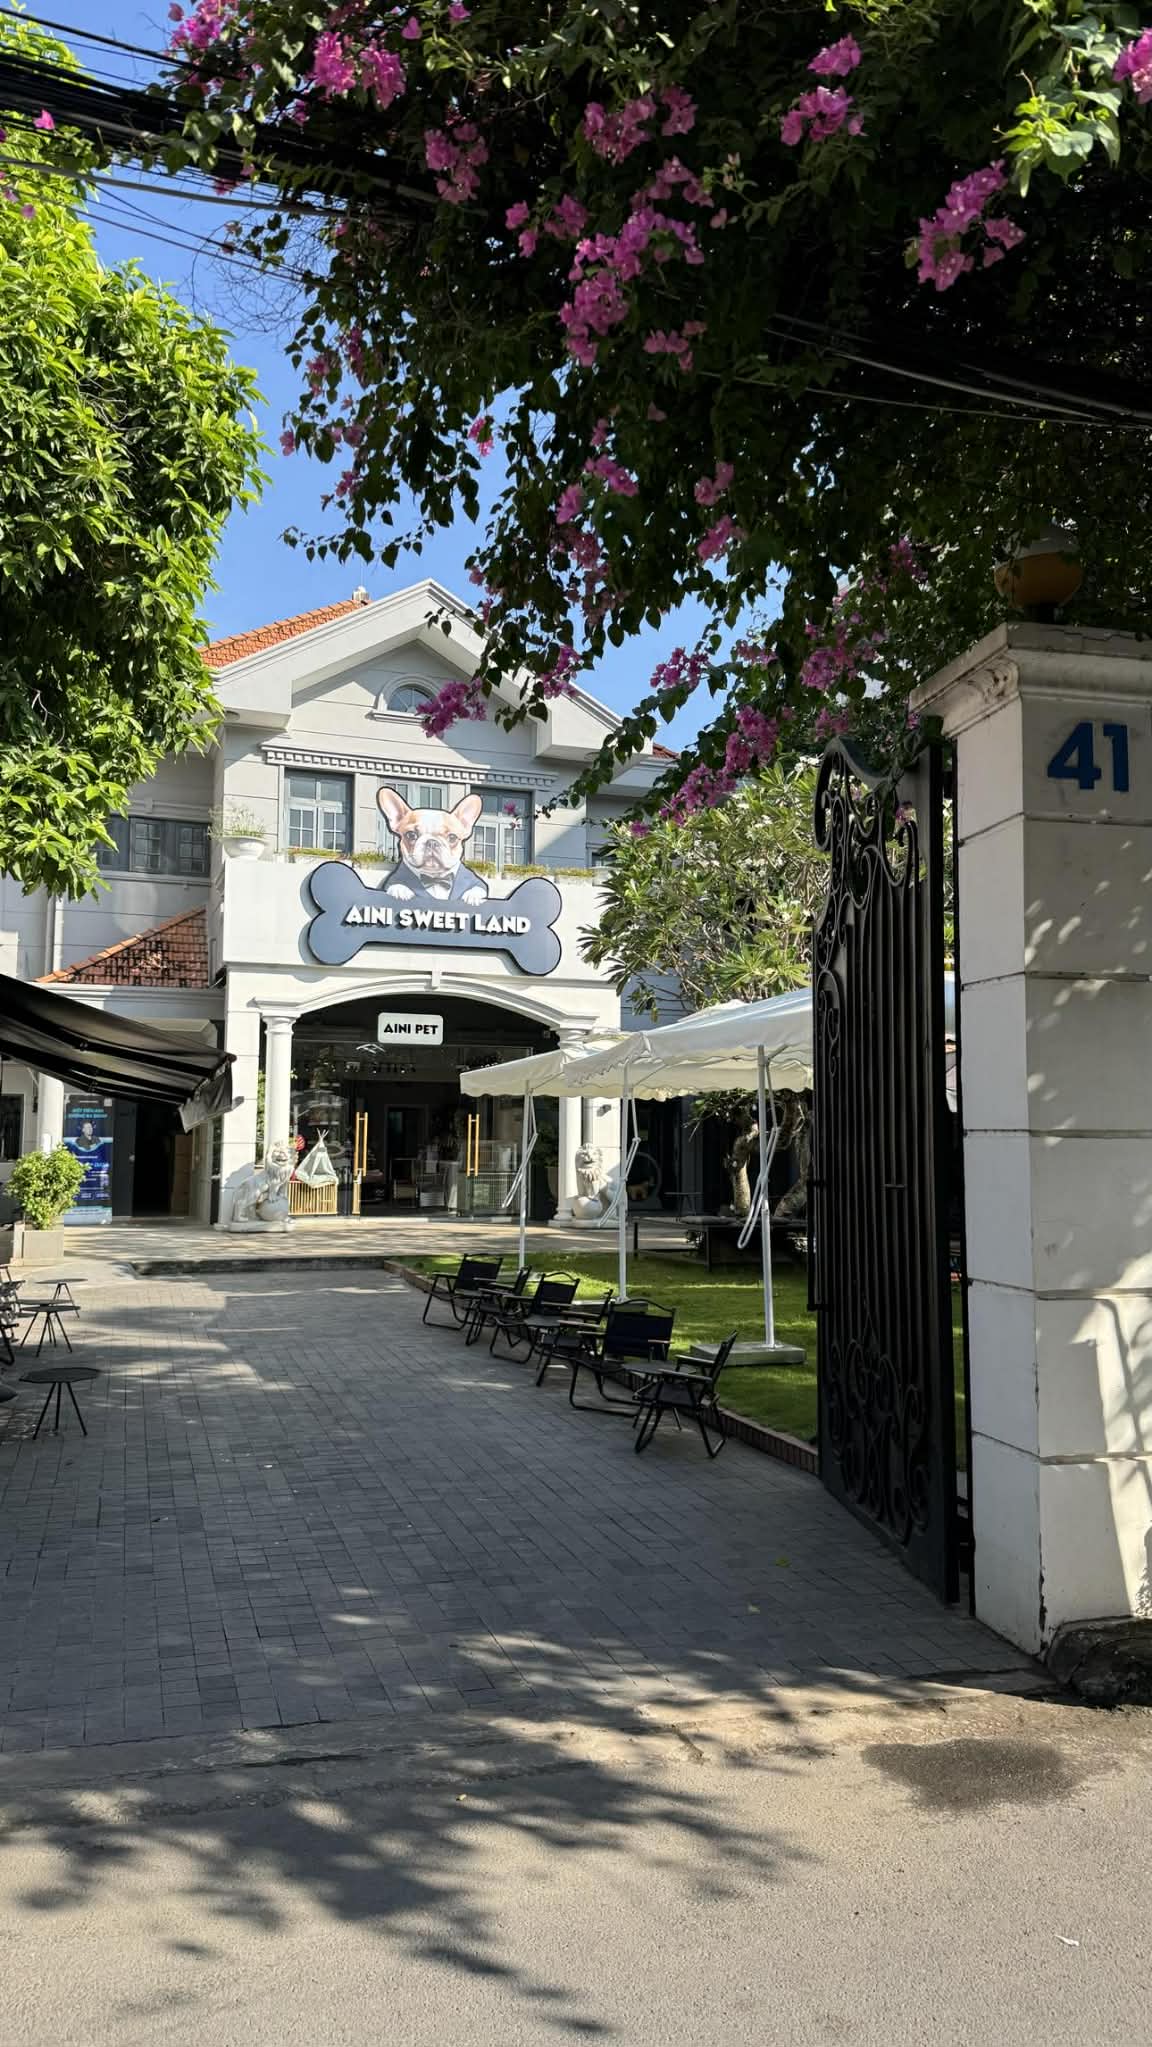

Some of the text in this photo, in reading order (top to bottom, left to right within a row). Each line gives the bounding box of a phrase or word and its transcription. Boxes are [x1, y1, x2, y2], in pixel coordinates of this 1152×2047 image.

[1047, 721, 1130, 792] 41
[344, 905, 532, 934] AINI SWEET LAND
[383, 1023, 439, 1035] AINI PET
